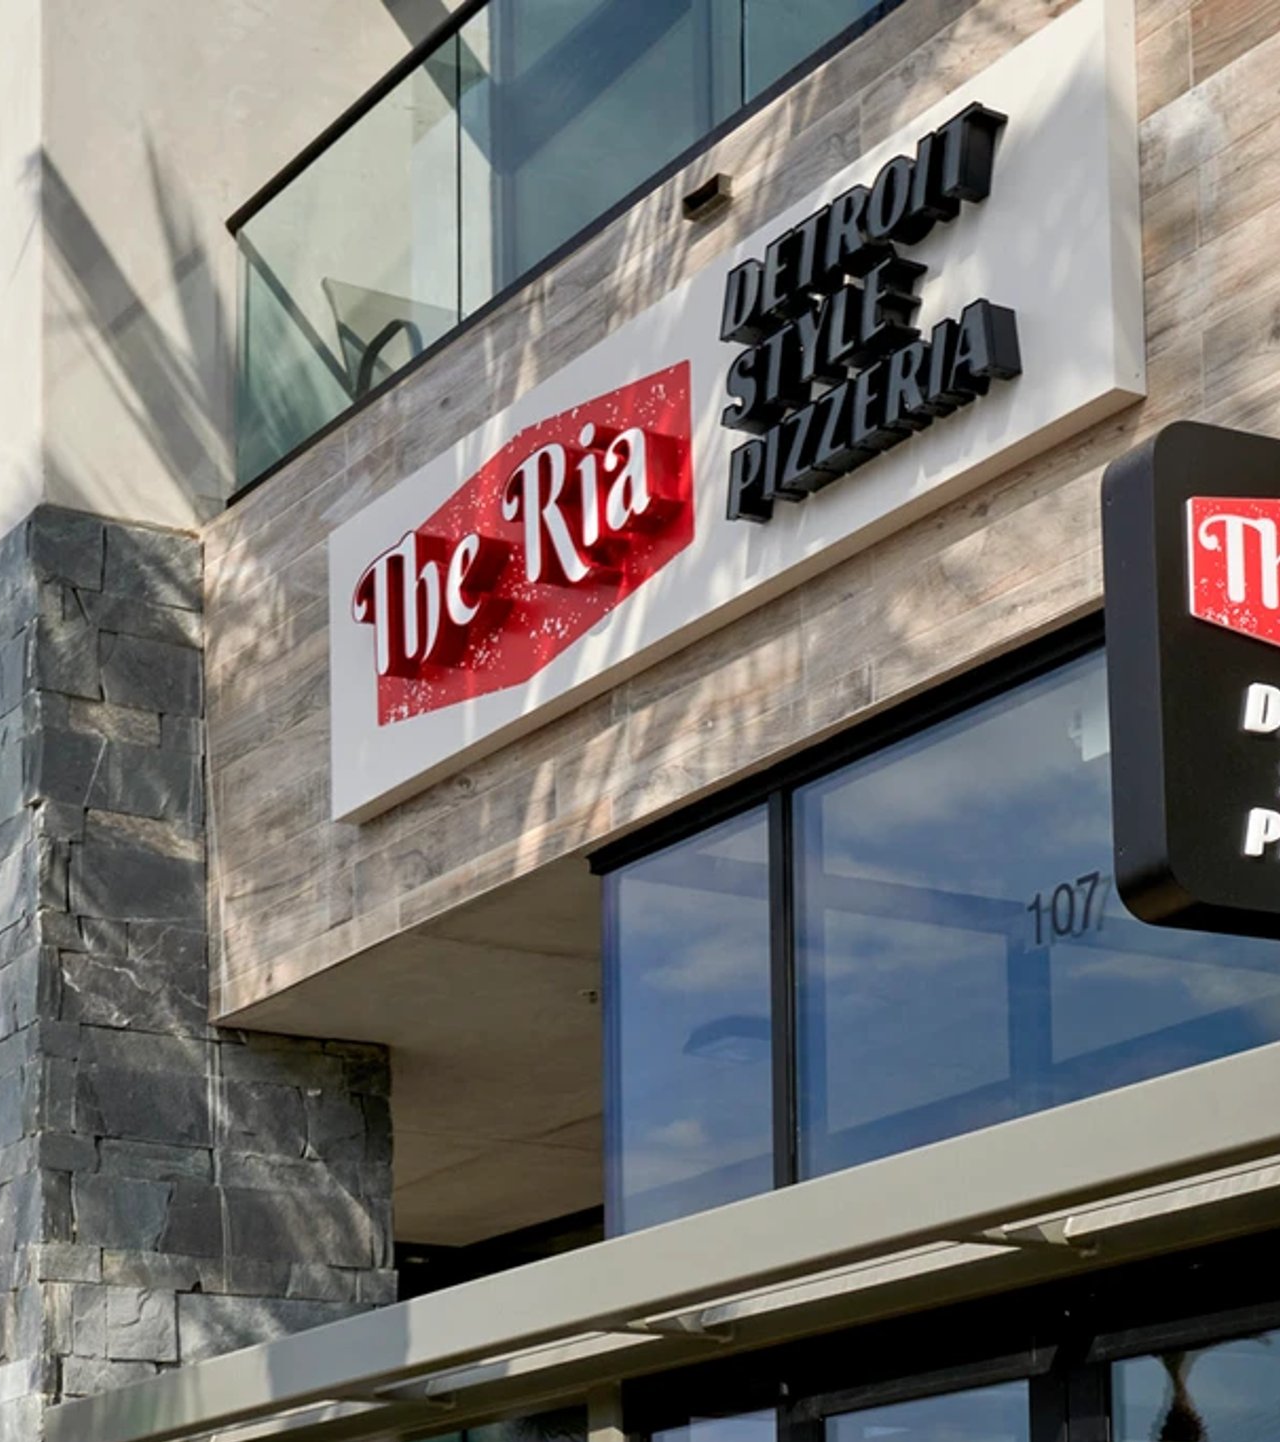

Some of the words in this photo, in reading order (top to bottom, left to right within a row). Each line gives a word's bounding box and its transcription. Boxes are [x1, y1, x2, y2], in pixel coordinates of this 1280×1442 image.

[720, 101, 1009, 342] DETROIT
[721, 254, 928, 430] STYLE
[726, 297, 1023, 523] PIZZERIA
[352, 530, 481, 677] The
[503, 420, 652, 584] Ria
[1026, 870, 1101, 946] 107
